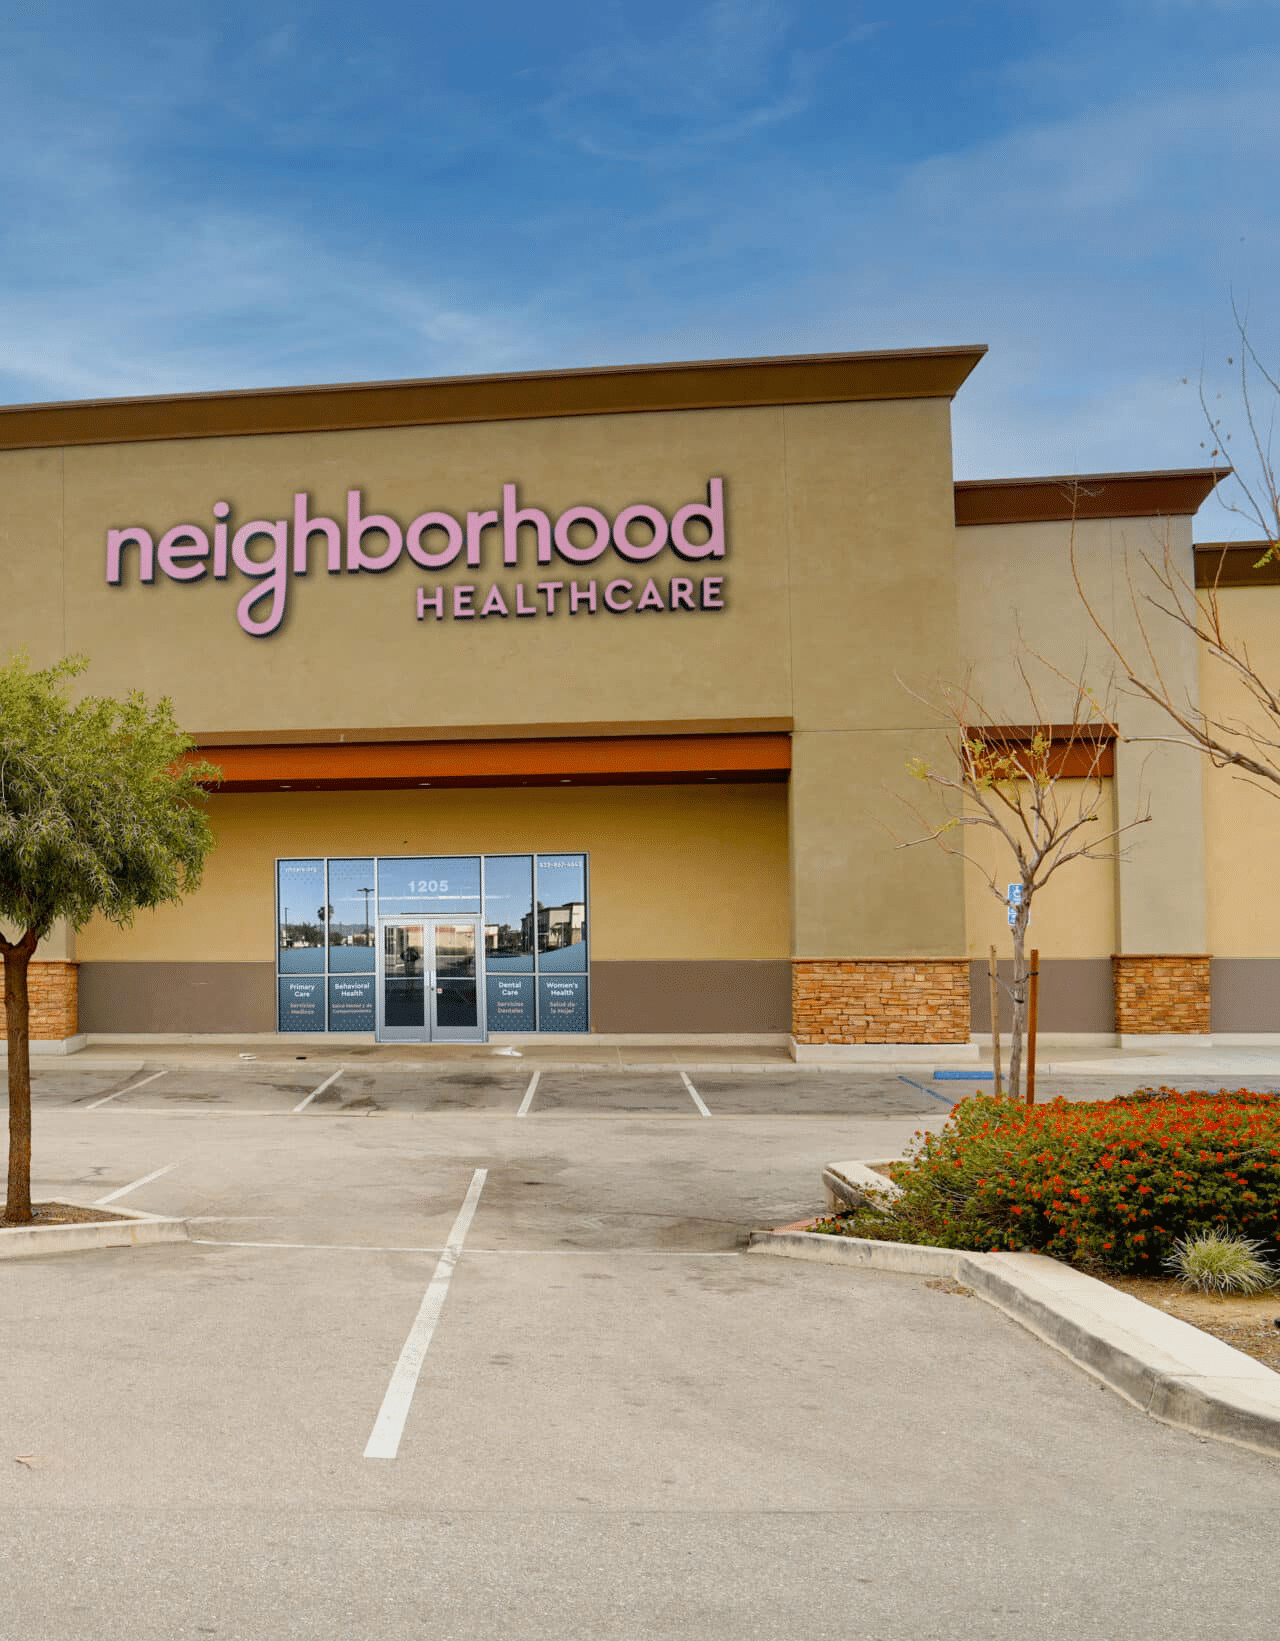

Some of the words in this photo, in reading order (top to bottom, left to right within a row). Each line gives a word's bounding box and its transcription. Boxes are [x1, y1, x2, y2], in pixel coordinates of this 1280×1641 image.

[106, 477, 726, 637] neighborhood
[416, 576, 725, 620] HEALTHCARE
[408, 880, 449, 893] 1205
[289, 983, 315, 991] Primary
[334, 982, 370, 990] Behavioral
[341, 989, 364, 997] Health
